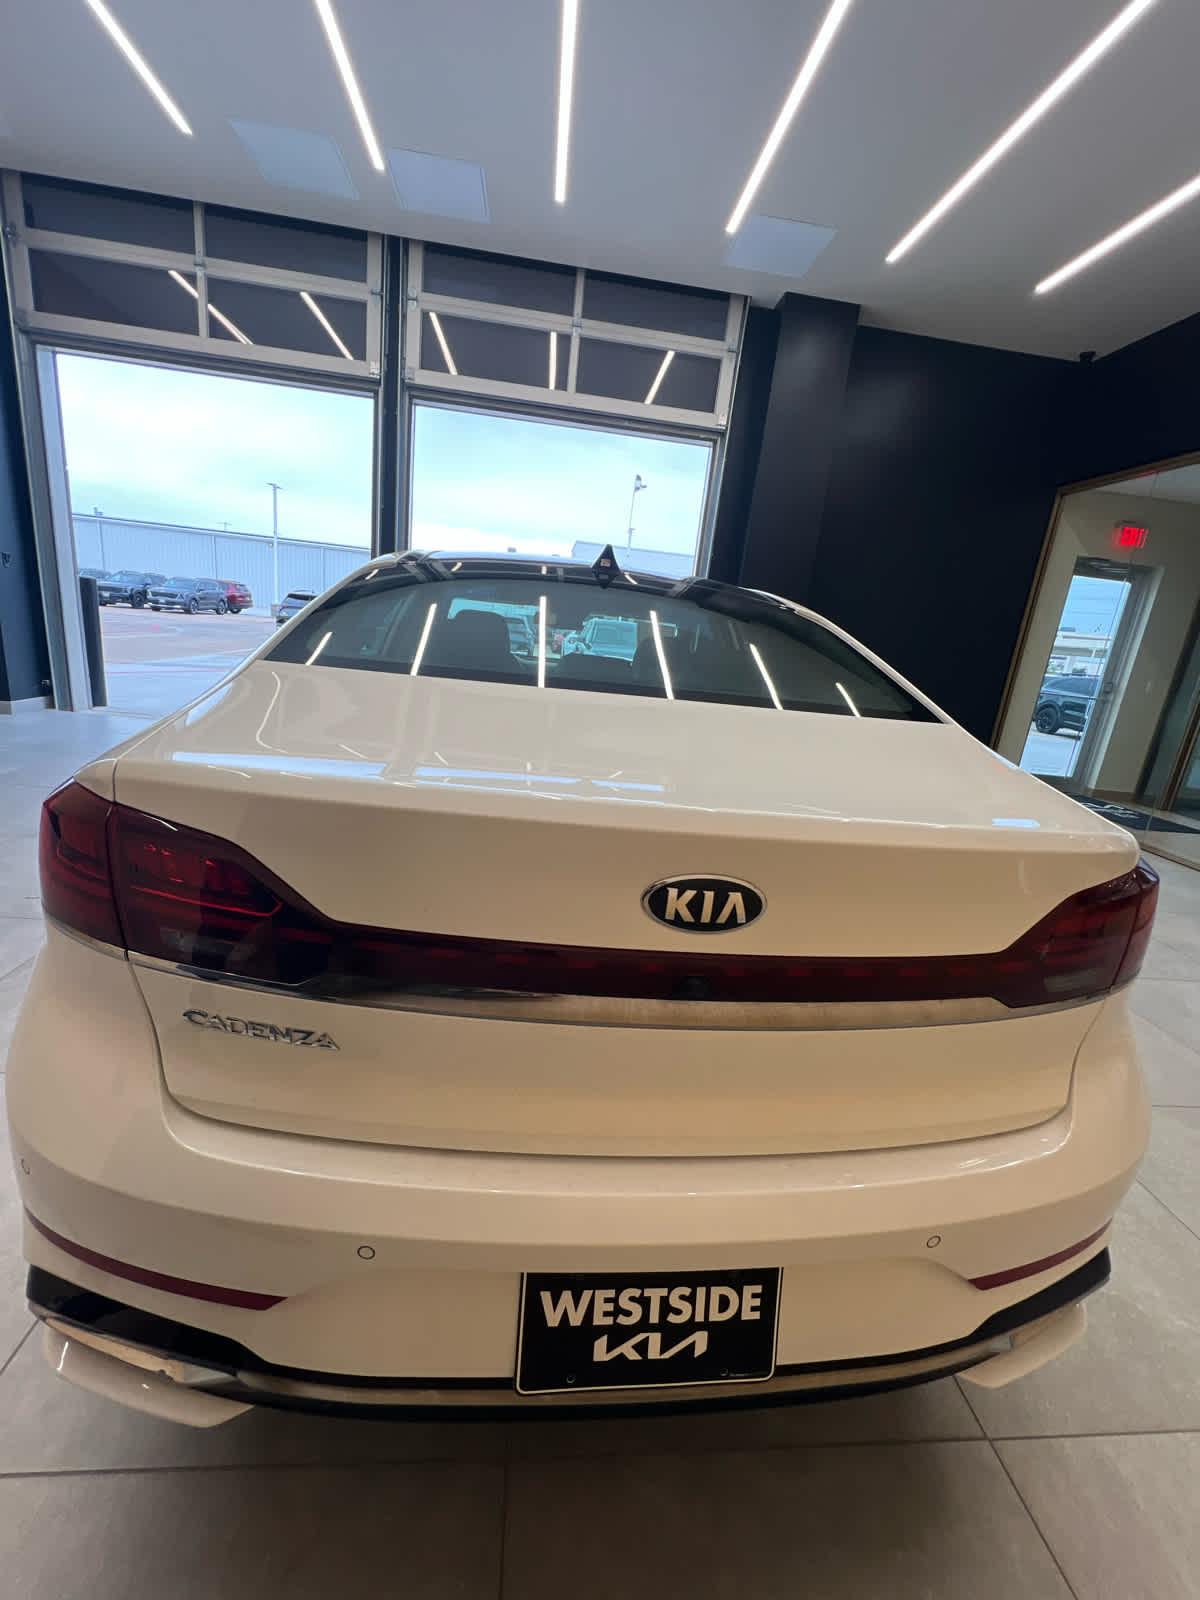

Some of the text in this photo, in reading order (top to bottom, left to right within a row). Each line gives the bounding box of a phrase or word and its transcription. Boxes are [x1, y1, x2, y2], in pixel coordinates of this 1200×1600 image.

[664, 887, 747, 924] KIA
[182, 1009, 341, 1050] CADENZA
[540, 1285, 763, 1328] WESTSIDE
[593, 1331, 708, 1362] KIA
